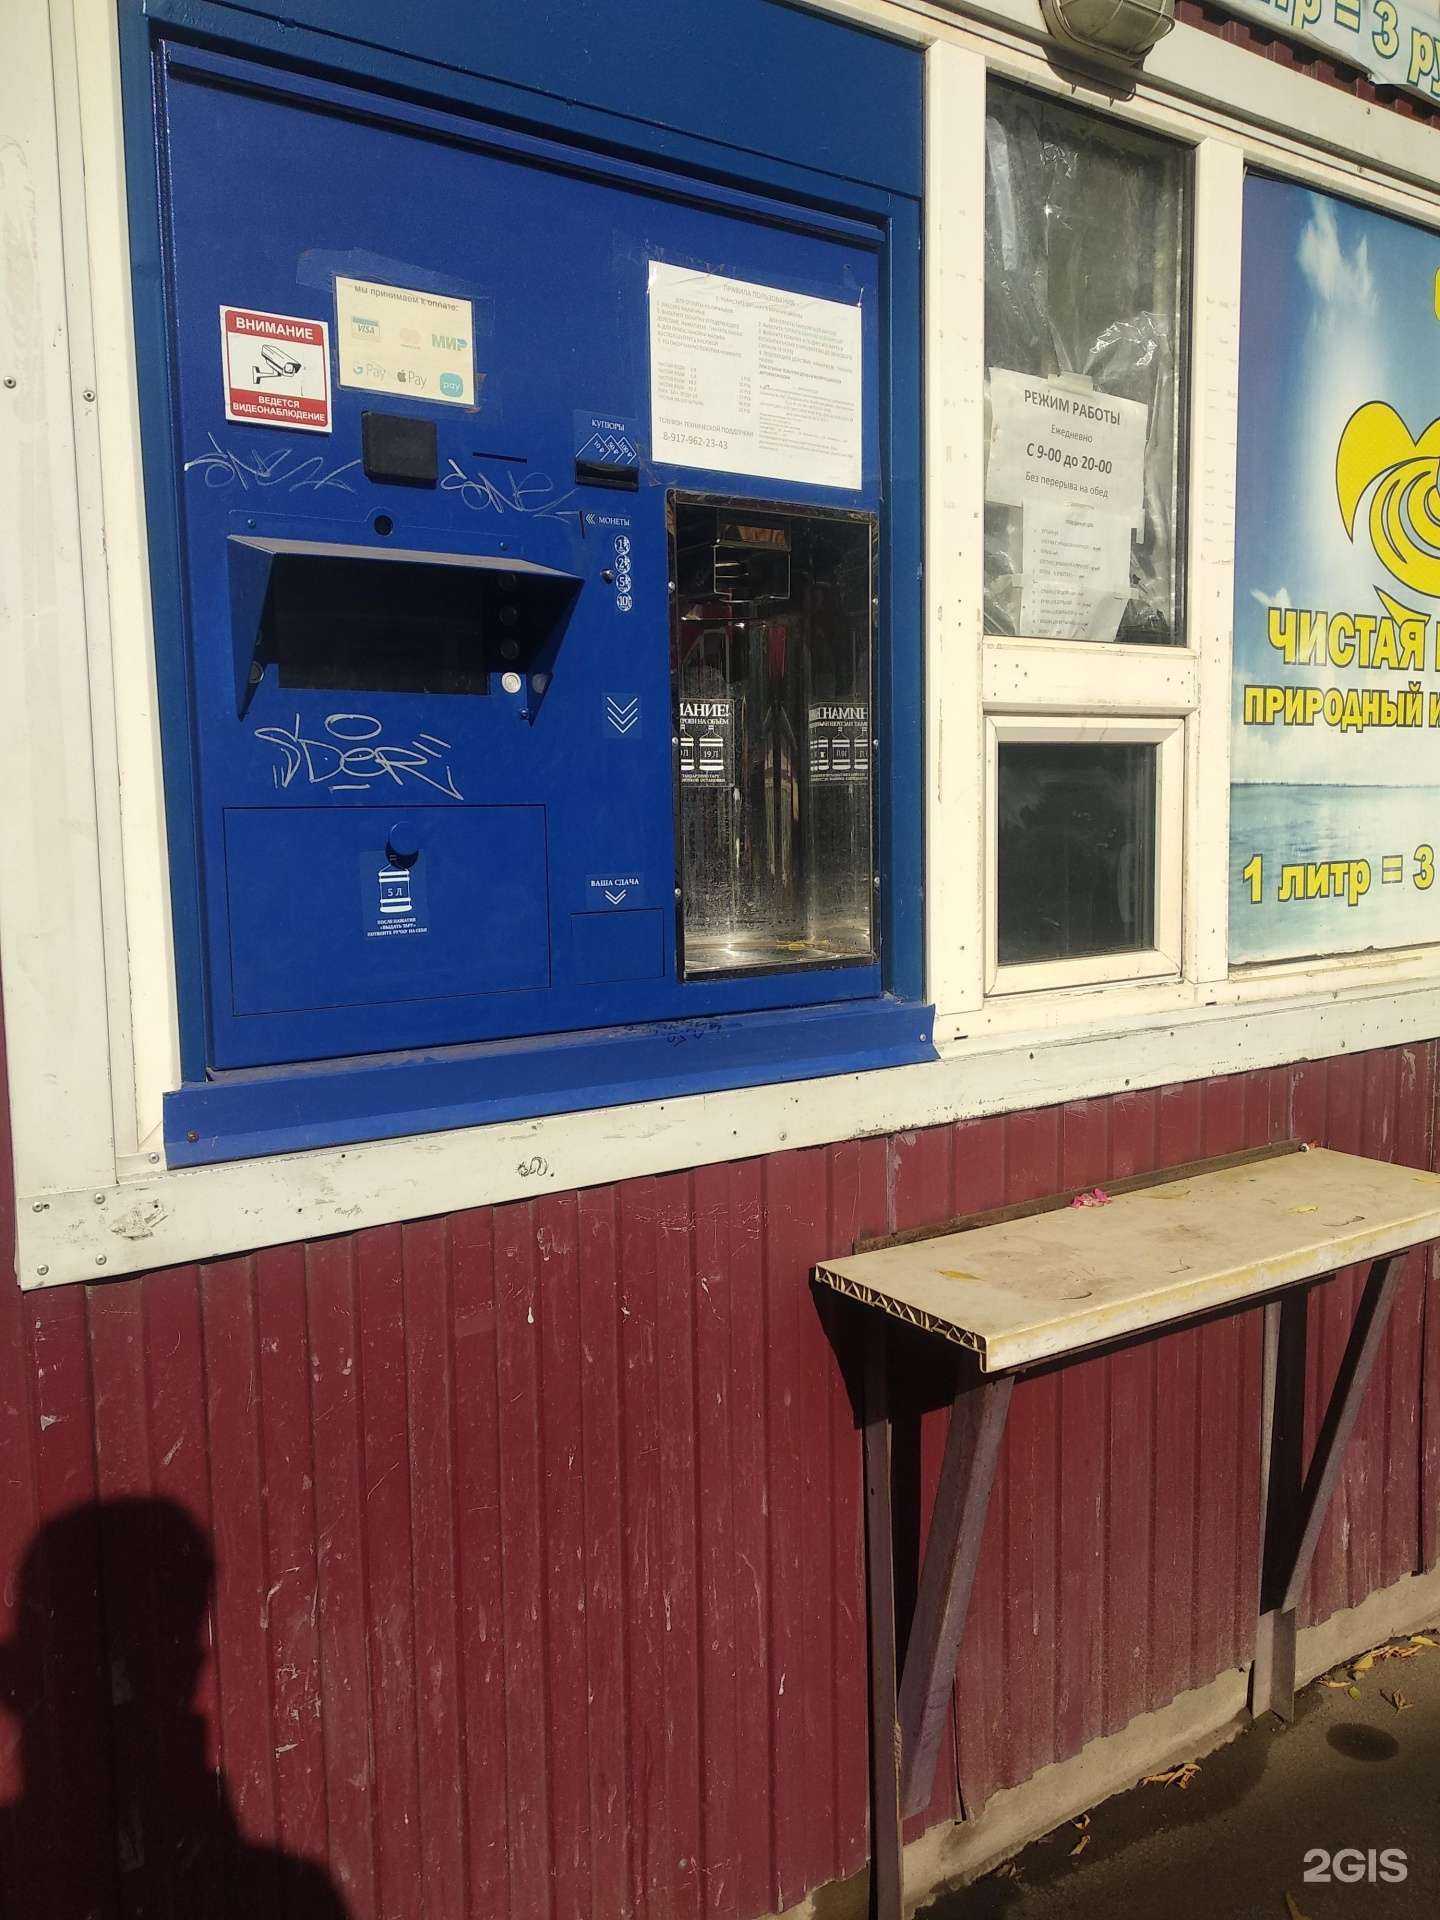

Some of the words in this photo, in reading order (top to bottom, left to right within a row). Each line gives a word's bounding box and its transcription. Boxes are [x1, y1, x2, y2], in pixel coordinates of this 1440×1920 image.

[1372, 0, 1399, 60] 3
[235, 317, 314, 340] ВНИМАНИЕ
[357, 324, 375, 335] VISA
[432, 334, 468, 351] МИР
[366, 363, 386, 382] Pay
[408, 370, 428, 390] Pay
[232, 402, 326, 421] ВИДЕОНАБЛЮДЕНИЕ
[258, 396, 300, 409] ВЕДЕТСЯ
[1024, 389, 1070, 414] РЕЖИМ
[1072, 401, 1120, 425] РАБОТЫ
[663, 431, 728, 449] 8-917-962-23-43
[1051, 424, 1093, 443] Ежедневно
[1026, 442, 1035, 457] С
[1037, 445, 1062, 463] 9-00
[1063, 454, 1079, 468] до
[1081, 455, 1113, 474] 20-00
[1025, 471, 1039, 483] Без
[1040, 475, 1078, 491] перерыва
[1079, 485, 1088, 494] на
[1089, 486, 1109, 498] обед
[599, 516, 630, 526] МОНЕТЫ
[1268, 607, 1425, 671] ЧИСТАЯ
[1244, 681, 1423, 733] ПРИРОДНЫЙ
[704, 750, 712, 758] 19
[590, 879, 613, 887] ВАША
[614, 878, 640, 886] СДАЧА
[1243, 854, 1262, 904] 1
[1278, 858, 1371, 907] литр
[1412, 844, 1435, 890] 3
[387, 888, 394, 897] 5
[395, 887, 402, 896] Л
